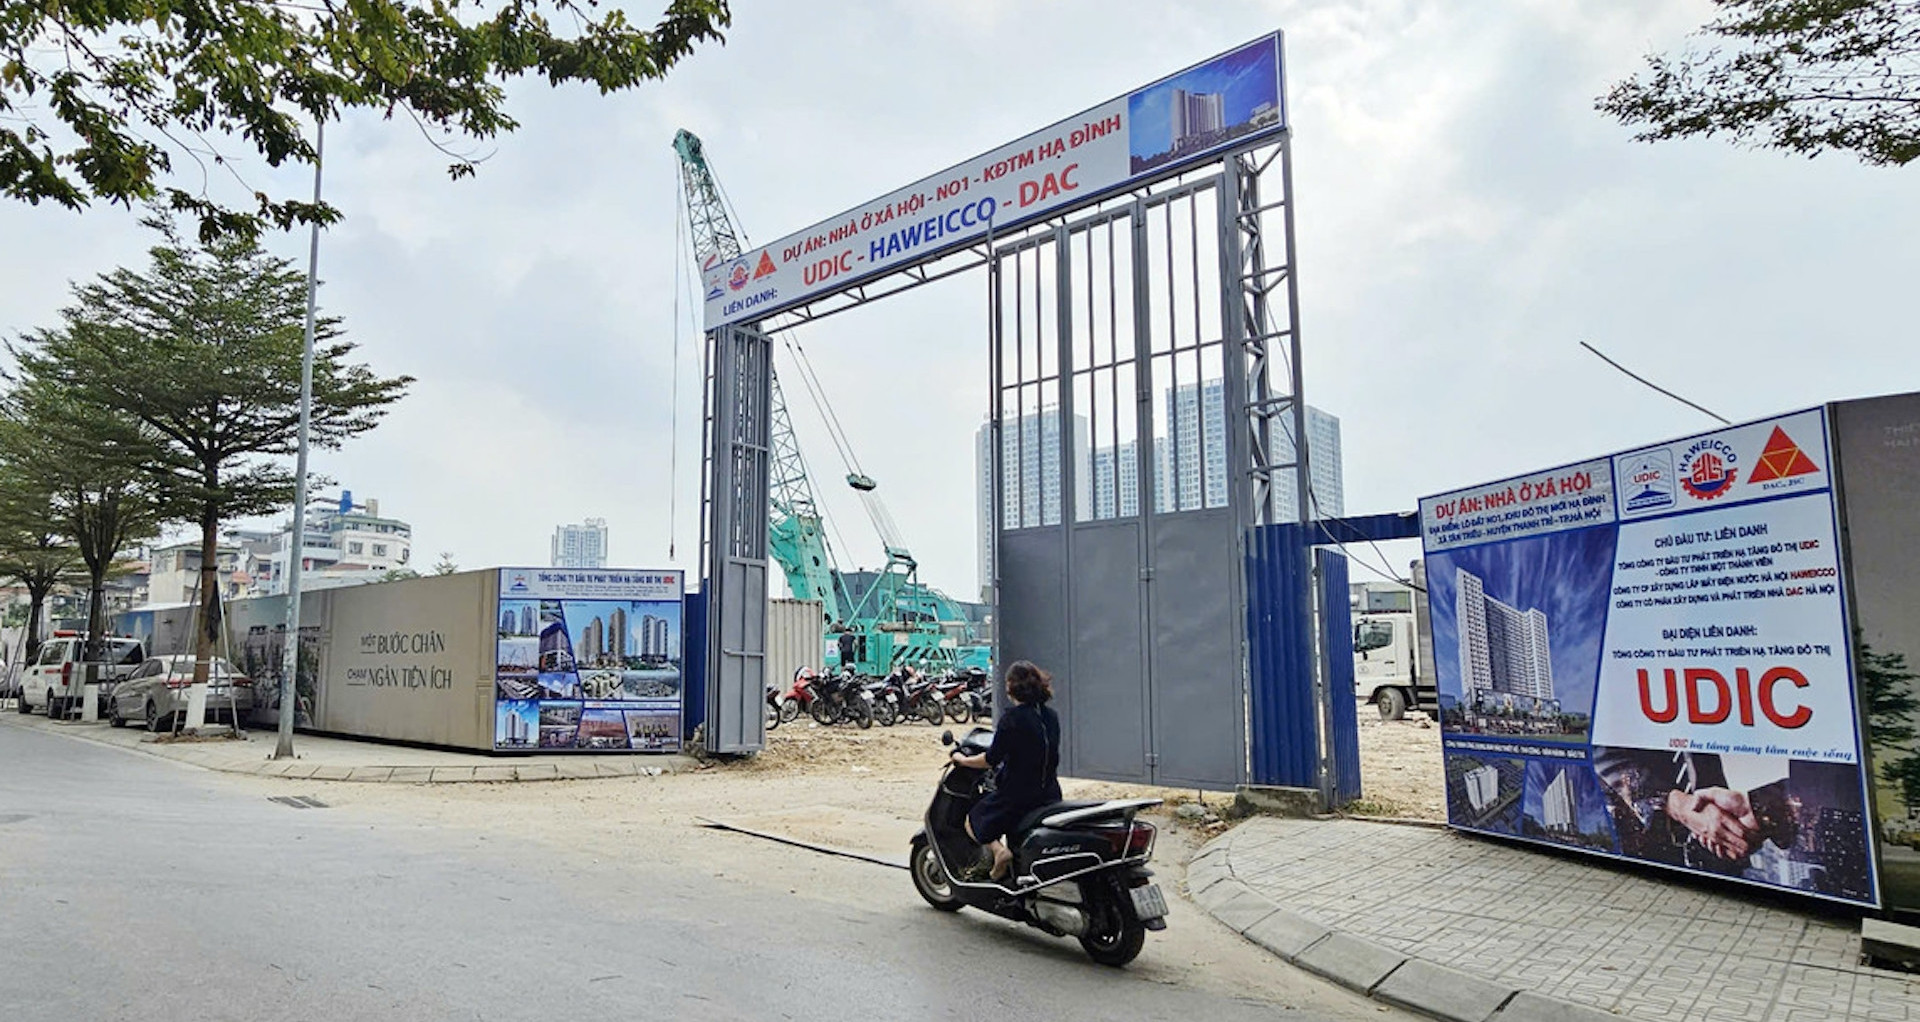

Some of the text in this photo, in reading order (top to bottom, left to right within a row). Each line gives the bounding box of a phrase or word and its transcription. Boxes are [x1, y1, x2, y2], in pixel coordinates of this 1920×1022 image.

[783, 242, 802, 262] DỰ
[804, 236, 826, 254] ÁN:
[829, 219, 857, 244] NHÀ
[861, 212, 872, 230] Ở
[875, 204, 894, 226] XÃ
[898, 193, 925, 217] HỘI
[936, 177, 968, 201] NO1
[983, 149, 1034, 183] KĐTM
[1038, 138, 1066, 161] HẠ
[1069, 114, 1121, 149] ĐÌNH
[803, 250, 853, 286] UDIC
[869, 197, 996, 263] HAWEICCO
[1019, 163, 1078, 208] DAC
[723, 288, 778, 317] LIÊN DANH:
[1679, 440, 1737, 472] HAWEICCO
[1634, 471, 1660, 483] UDIC
[1436, 471, 1591, 520] DỰ ÁN: NHÀ Ở XÃ HỘI
[1523, 507, 1534, 517] ĐÔ
[1655, 534, 1673, 548] CHỦ
[1715, 527, 1736, 540] LIÊN
[1739, 523, 1768, 537] DANH
[1799, 540, 1819, 550] UDIC
[1786, 586, 1804, 596] DAC
[377, 631, 409, 654] BƯỚC
[412, 630, 445, 654] CHÂN
[1702, 625, 1724, 638] LIÊN
[1726, 625, 1757, 637] DANH:
[1656, 649, 1666, 657] TY
[1752, 646, 1766, 657] HẠ
[1797, 643, 1812, 655] ĐÔ
[1813, 644, 1831, 656] THỊ
[368, 664, 399, 687] NGÀN
[401, 665, 427, 691] TIỆN
[430, 665, 452, 689] ÍCH
[1636, 666, 1813, 729] UDIC
[1669, 738, 1688, 748] UDIC
